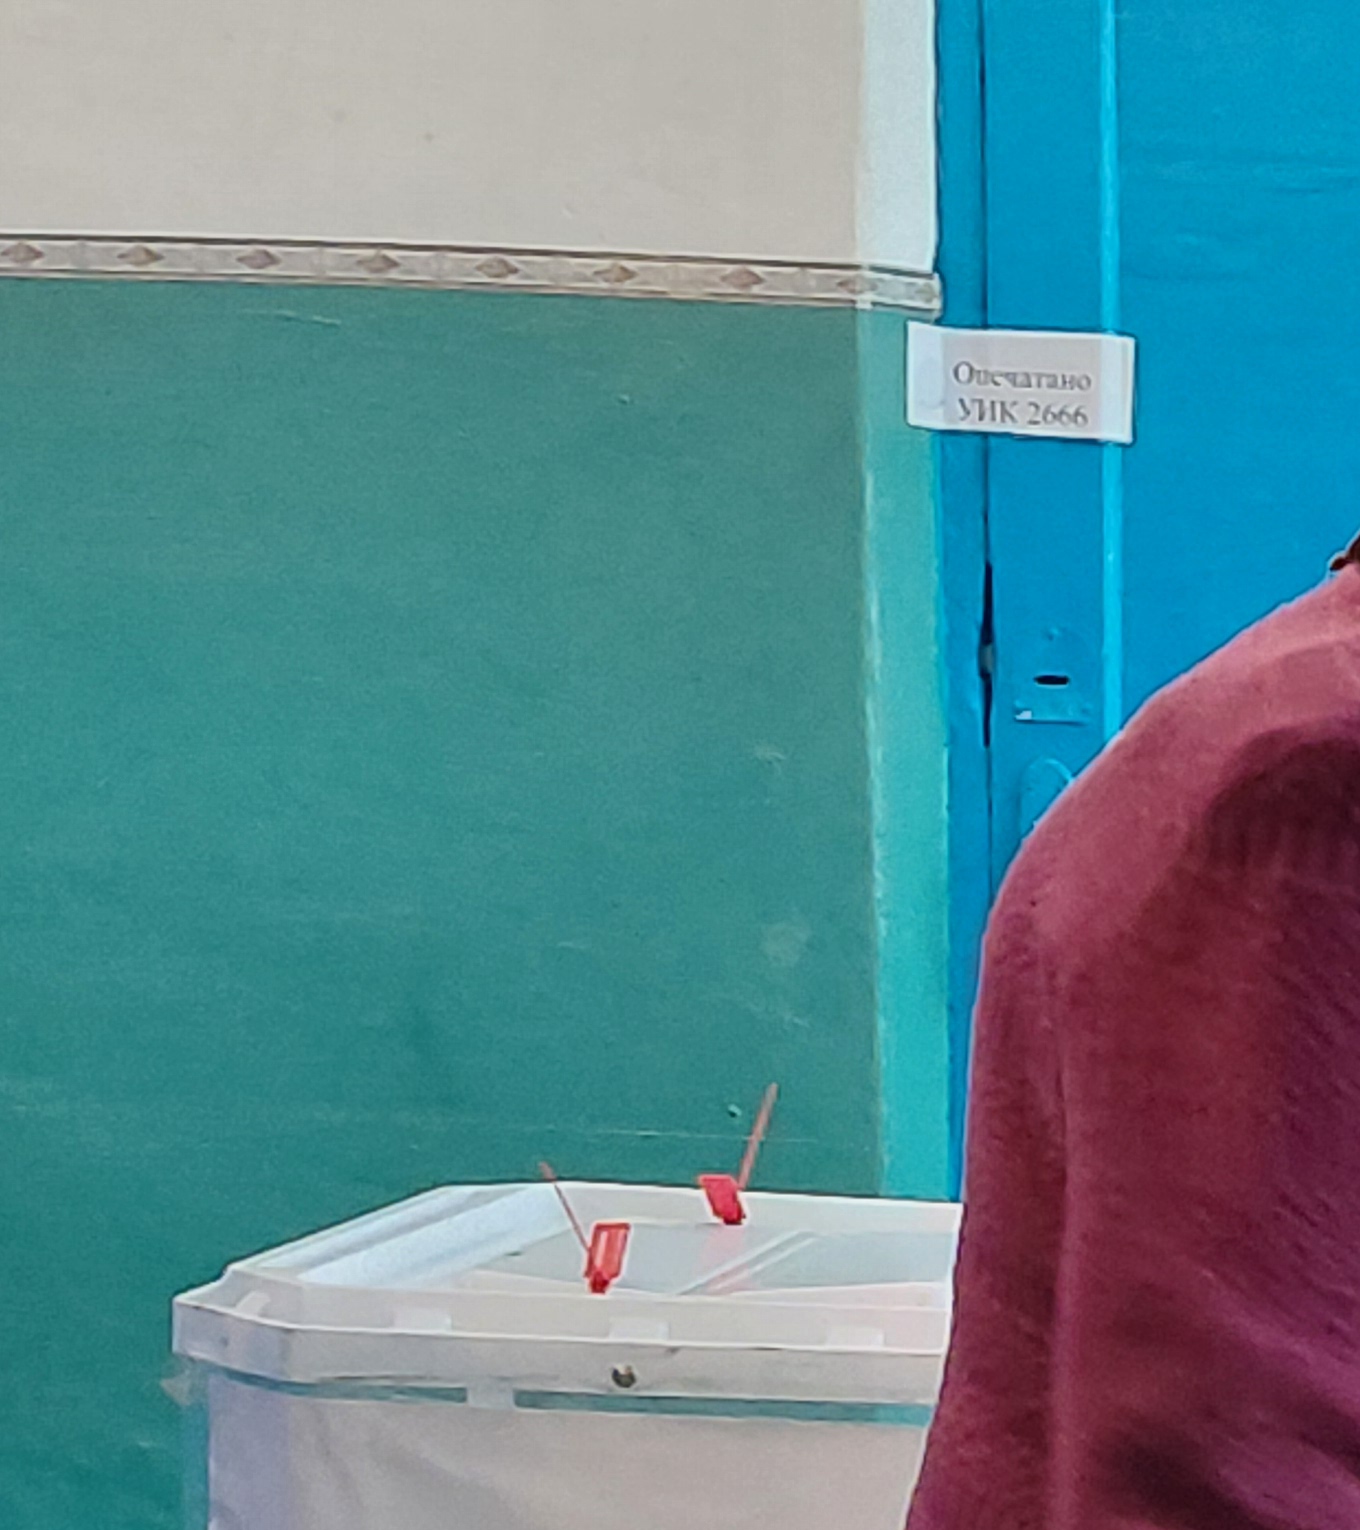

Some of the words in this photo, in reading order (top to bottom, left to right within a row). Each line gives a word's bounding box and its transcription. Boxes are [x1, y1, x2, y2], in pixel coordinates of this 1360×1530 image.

[953, 360, 1092, 391] Опечатано
[958, 397, 1020, 424] УИК
[1026, 400, 1089, 427] 2666
